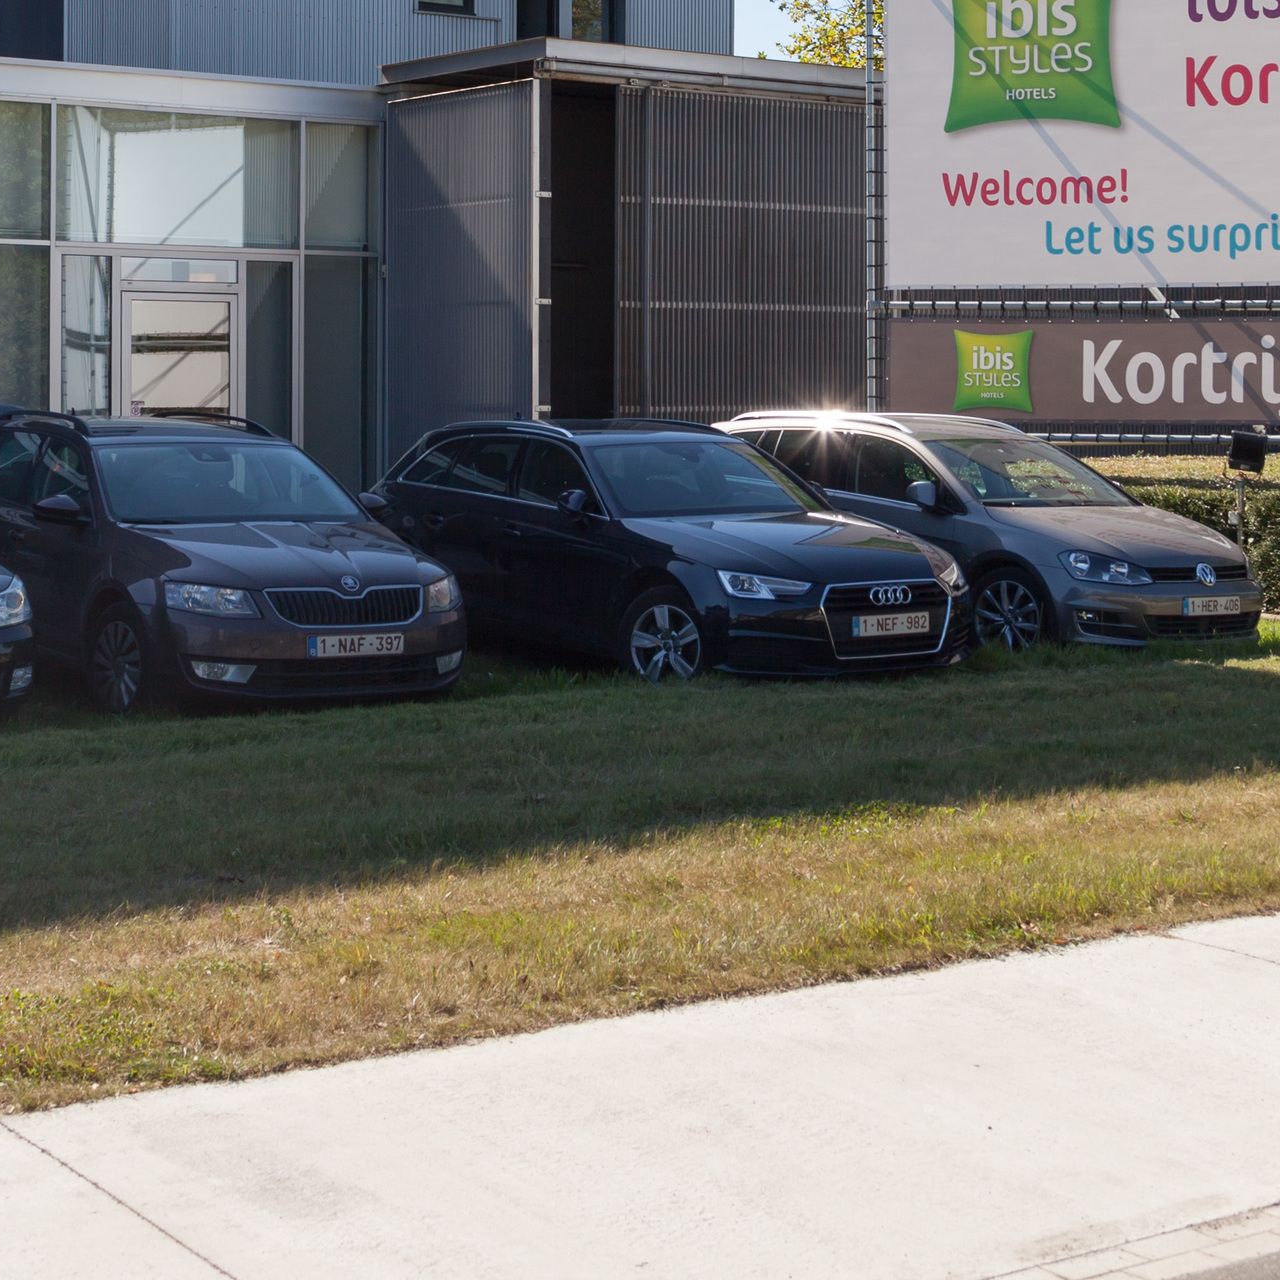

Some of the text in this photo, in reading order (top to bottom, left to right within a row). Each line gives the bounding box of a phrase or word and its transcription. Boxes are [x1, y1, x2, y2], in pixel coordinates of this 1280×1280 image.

[1005, 87, 1057, 101] HOTELS
[941, 168, 1130, 208] Welcome!
[1044, 219, 1102, 256] Let
[1112, 222, 1156, 256] us
[972, 345, 1015, 371] ibis
[980, 391, 1005, 400] HOTELS
[862, 614, 928, 633] 1-NEF-982
[320, 635, 403, 655] 1-NAF-397
